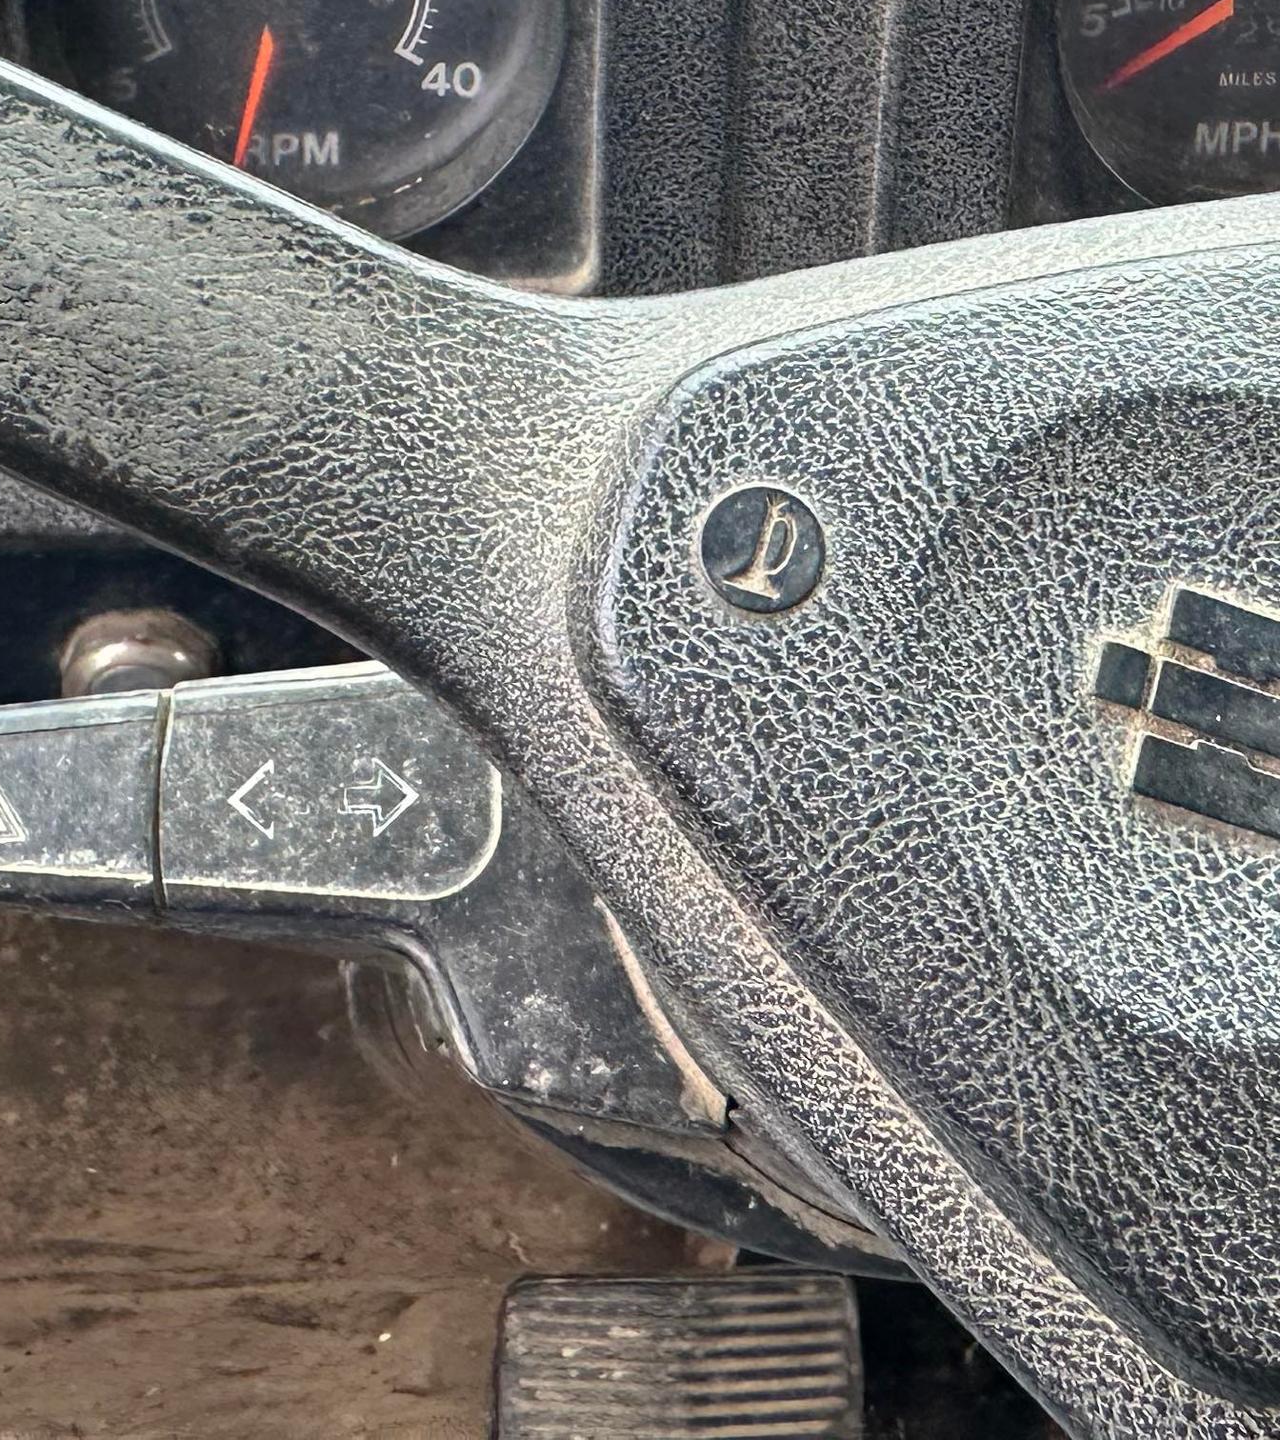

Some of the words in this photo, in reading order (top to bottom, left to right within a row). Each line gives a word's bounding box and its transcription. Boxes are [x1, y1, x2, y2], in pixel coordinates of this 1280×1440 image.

[1080, 2, 1108, 38] 5
[114, 68, 137, 102] 5
[421, 62, 483, 98] 40
[1219, 71, 1277, 88] MILES
[242, 130, 340, 166] RPM
